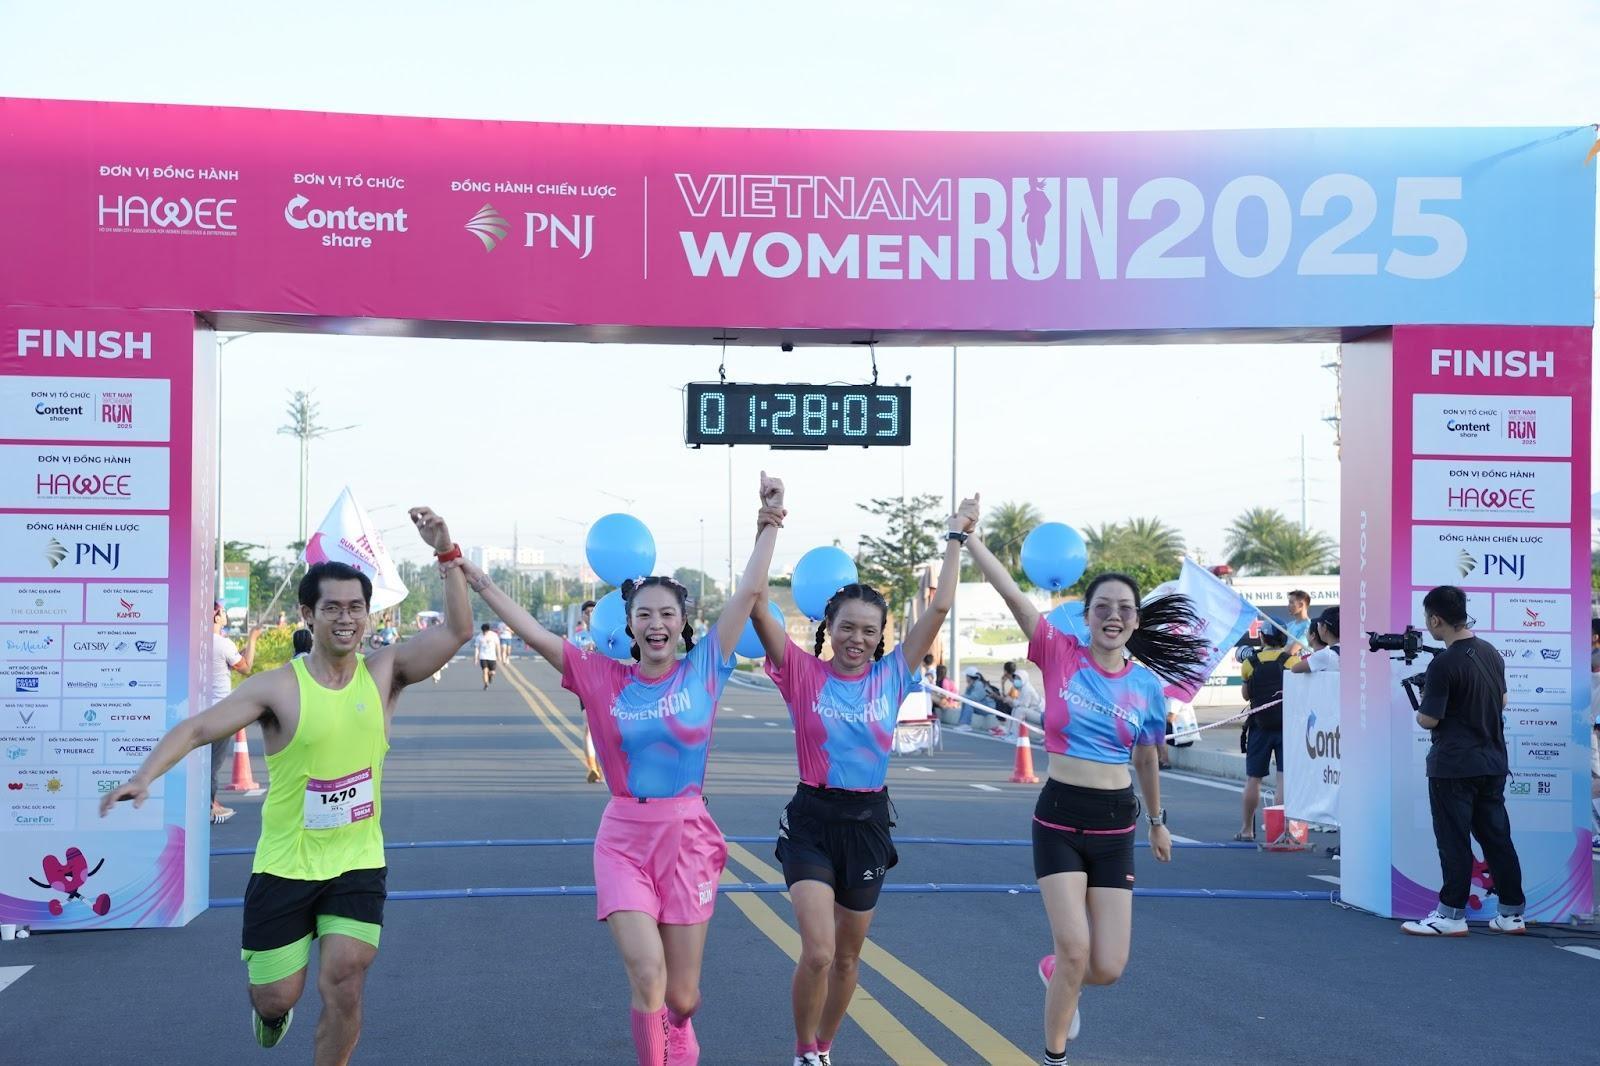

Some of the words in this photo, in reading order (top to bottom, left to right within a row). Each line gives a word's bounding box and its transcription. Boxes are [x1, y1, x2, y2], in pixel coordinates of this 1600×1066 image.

[100, 165, 132, 177] ĐƠN
[136, 167, 149, 180] VỊ
[153, 165, 195, 179] ĐỒNG
[199, 168, 239, 181] HÀNH
[294, 173, 325, 185] ĐƠN
[328, 176, 342, 188] VỊ
[345, 174, 363, 187] TỔ
[367, 176, 405, 189] CHỨC
[451, 179, 491, 193] ĐỒNG
[495, 181, 533, 194] HÀNH
[536, 182, 577, 196] CHIẾN
[581, 185, 617, 199] LƯỢC
[674, 173, 951, 221] VIETNAM
[99, 195, 237, 230] HAWEE
[284, 193, 408, 233] Content
[524, 212, 595, 260] PNJ
[679, 231, 952, 280] WOMEN
[958, 177, 1118, 281] RUN
[1126, 173, 1468, 280] 2025
[322, 233, 372, 248] share
[17, 328, 152, 360] FINISH
[1431, 349, 1554, 377] FINISH
[70, 391, 91, 399] CHỨC
[35, 401, 84, 415] Content
[102, 404, 132, 423] RUN
[700, 392, 898, 437] 01:28:03
[1447, 419, 1490, 432] Content
[1508, 421, 1536, 439] RUN
[38, 455, 60, 463] ĐƠN
[62, 456, 71, 464] VỊ
[73, 454, 102, 464] ĐỒNG
[104, 455, 131, 464] HÀNH
[1449, 469, 1469, 477] ĐƠN
[1482, 469, 1508, 478] ĐỒNG
[1510, 470, 1535, 478] HÀNH
[37, 473, 132, 496] HAWEE
[1449, 487, 1535, 509] HAWEE
[26, 522, 54, 530] ĐỒNG
[56, 523, 83, 531] HÀNH
[85, 522, 113, 531] CHIẾN
[115, 524, 140, 533] LƯỢC
[1439, 533, 1464, 542] ĐỒNG
[1466, 534, 1491, 543] HÀNH
[1493, 535, 1518, 543] CHIẾN
[1520, 536, 1543, 544] LƯỢC
[75, 543, 120, 571] PNJ
[1484, 554, 1525, 581] PNJ
[1256, 591, 1273, 600] NHI
[1310, 591, 1339, 599] SANH
[73, 641, 109, 651] GATSBY
[609, 704, 658, 721] WOMEN
[812, 701, 864, 723] WOMEN
[1059, 688, 1113, 718] WOMEN
[321, 787, 357, 805] 1470
